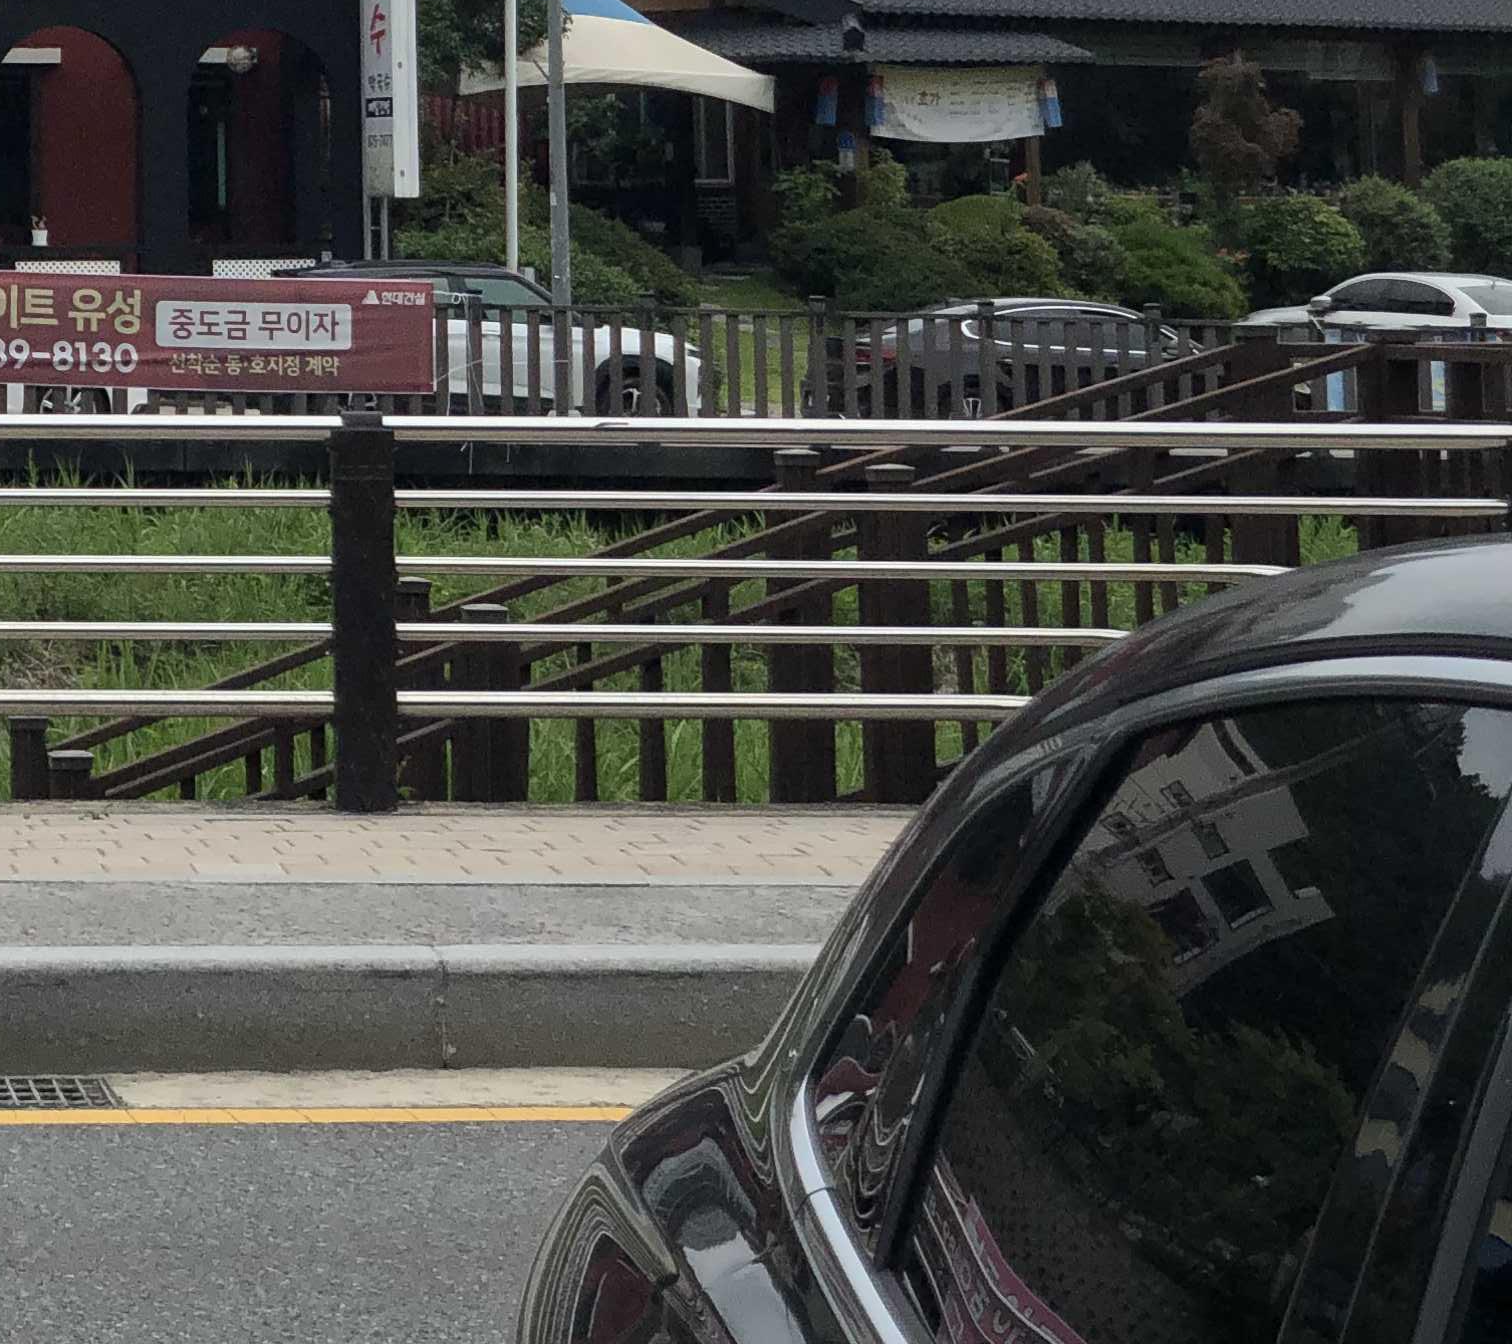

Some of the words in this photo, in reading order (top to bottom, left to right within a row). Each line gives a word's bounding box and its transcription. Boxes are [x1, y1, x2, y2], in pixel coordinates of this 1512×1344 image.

[67, 287, 143, 335] 유성
[379, 291, 426, 306] 현대건설
[167, 307, 251, 342] 중도금
[257, 309, 341, 343] 무이자
[167, 352, 221, 375] 선착순
[304, 356, 342, 377] 계약
